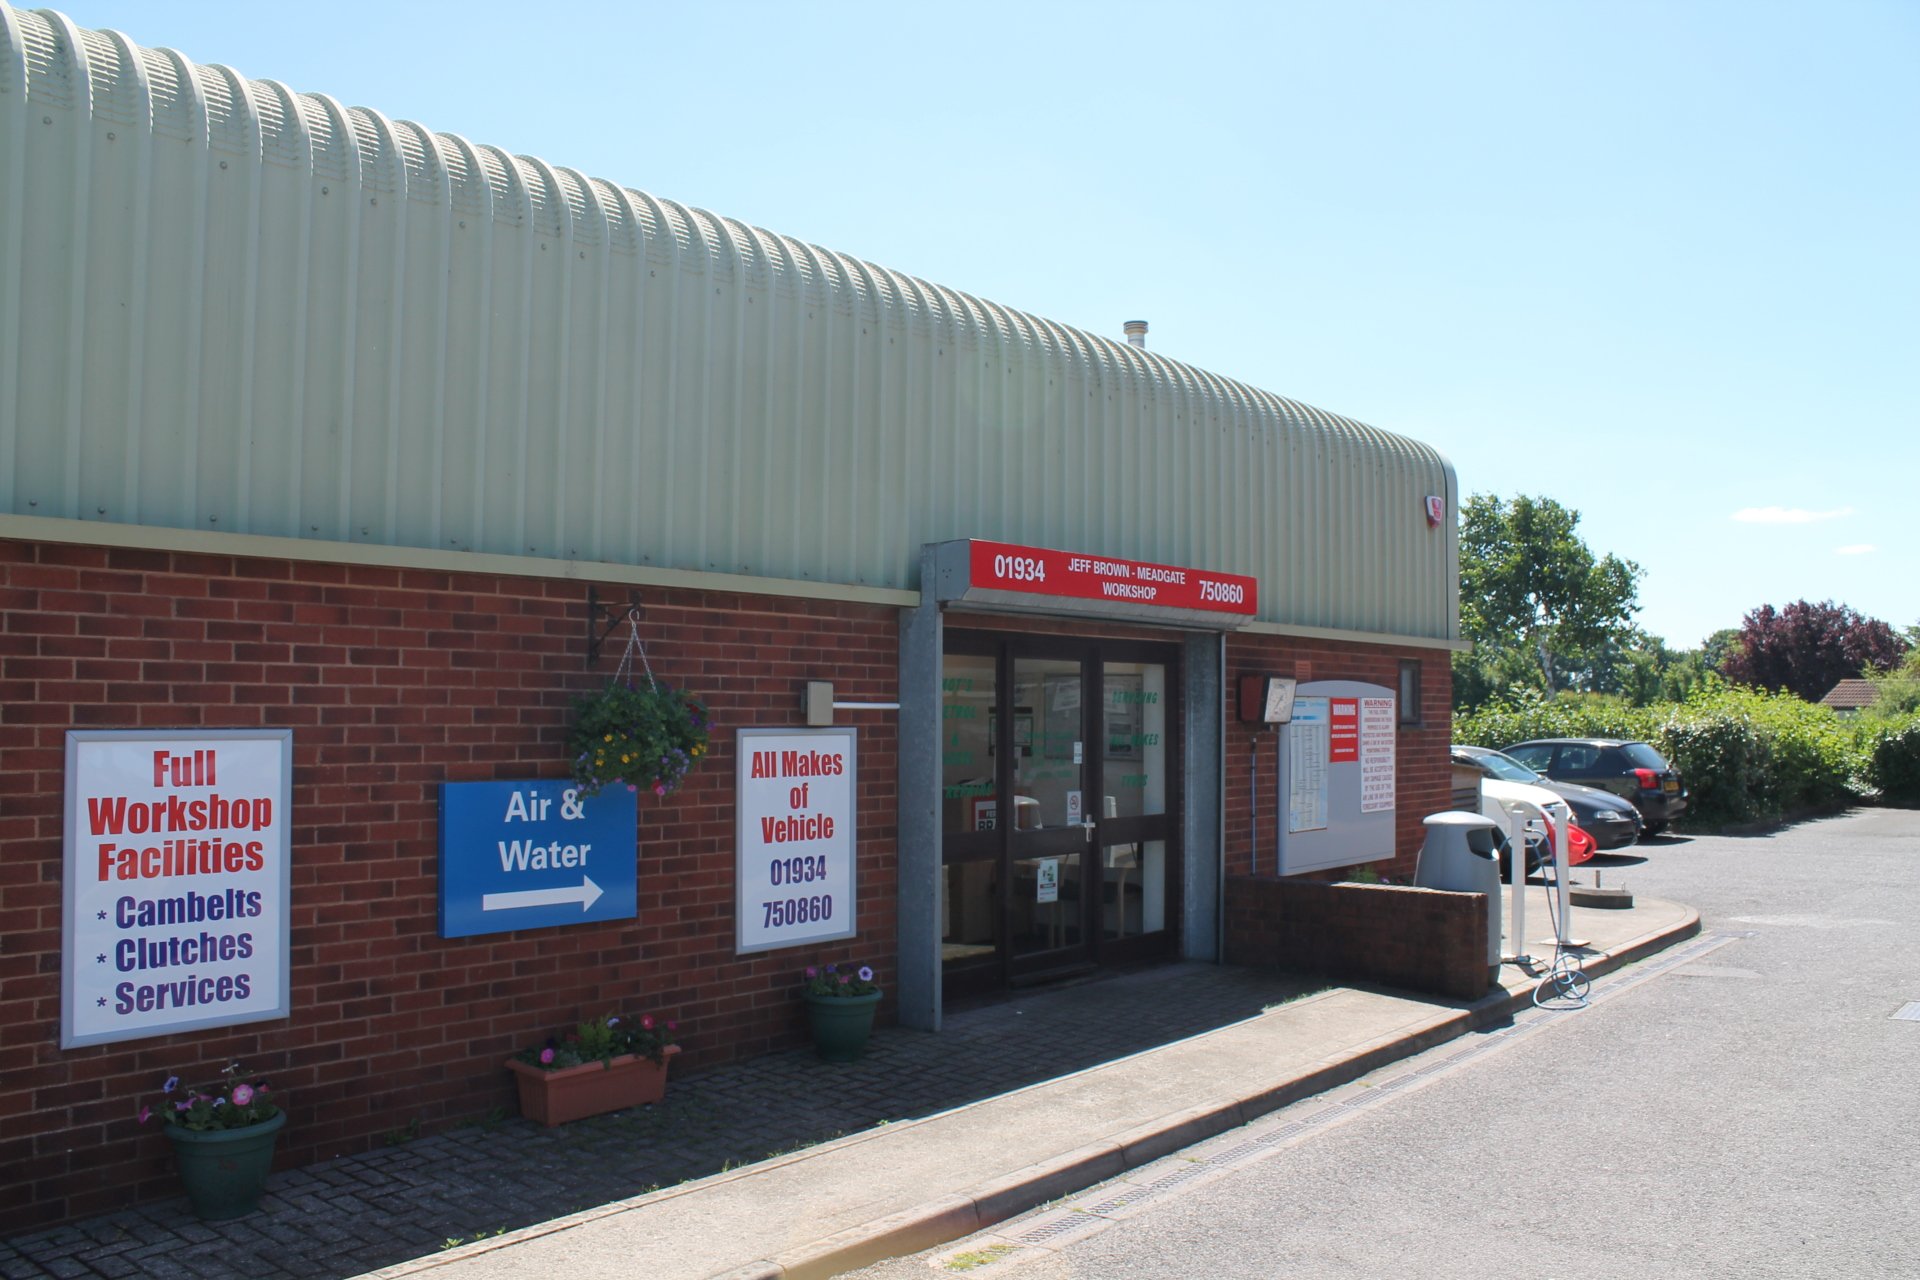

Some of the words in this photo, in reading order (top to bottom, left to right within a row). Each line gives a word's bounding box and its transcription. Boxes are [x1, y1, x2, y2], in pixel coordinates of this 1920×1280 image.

[994, 554, 1045, 582] 01934
[1068, 557, 1092, 573] JEFF
[1093, 561, 1130, 578] BROWN
[1137, 567, 1186, 585] MEADGATE
[1102, 581, 1157, 600] WORKSHOP
[1199, 580, 1243, 604] 750860
[153, 749, 216, 788] Full
[751, 751, 777, 779] All
[781, 749, 843, 778] Makes
[504, 790, 551, 822] Air
[560, 789, 585, 820] &
[790, 782, 809, 810] of
[87, 794, 272, 836] Workshop
[761, 813, 834, 844] Vehicle
[98, 837, 264, 882] Facilities
[498, 840, 591, 872] Water
[770, 855, 827, 886] 01934
[115, 888, 262, 929] Cambelts
[762, 895, 833, 929] 750860
[115, 932, 253, 972] Clutches
[115, 973, 251, 1015] Services
